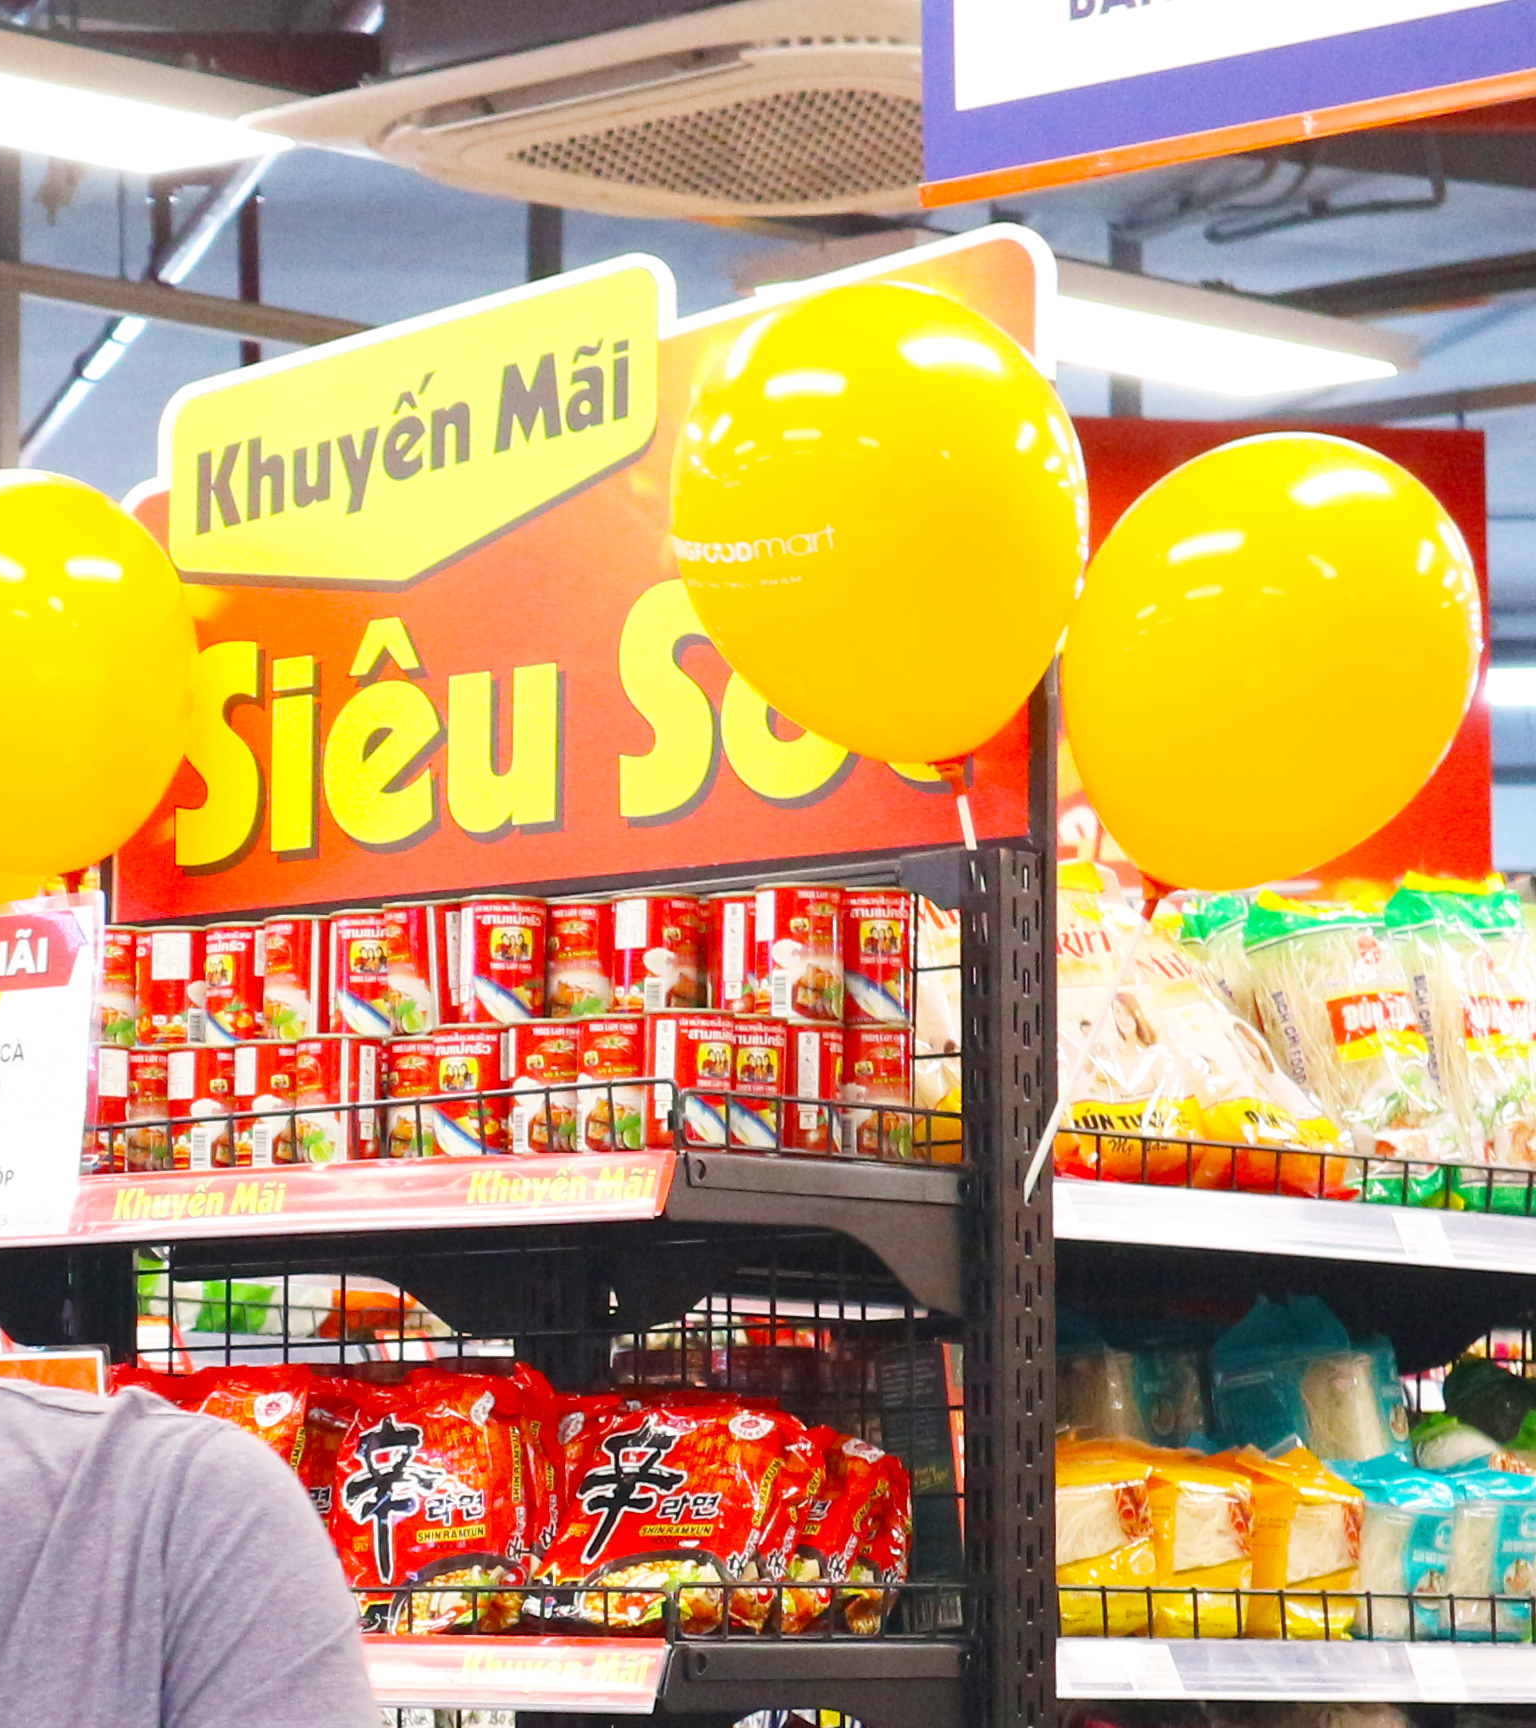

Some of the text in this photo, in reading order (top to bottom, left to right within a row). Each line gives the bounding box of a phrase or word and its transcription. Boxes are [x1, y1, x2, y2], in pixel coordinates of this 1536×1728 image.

[194, 337, 631, 537] Khuyến Mãi
[174, 617, 568, 872] Siêu
[113, 1180, 286, 1222] Khuyến Mãi
[466, 1157, 658, 1212] Khuyến Mãi
[344, 1413, 422, 1585] 辛
[426, 1491, 486, 1526] 라면
[578, 1417, 687, 1565] 辛
[659, 1493, 722, 1523] 라면
[417, 1526, 485, 1543] SHIN RAMYUN
[640, 1524, 712, 1537] SHIN RAMYUN
